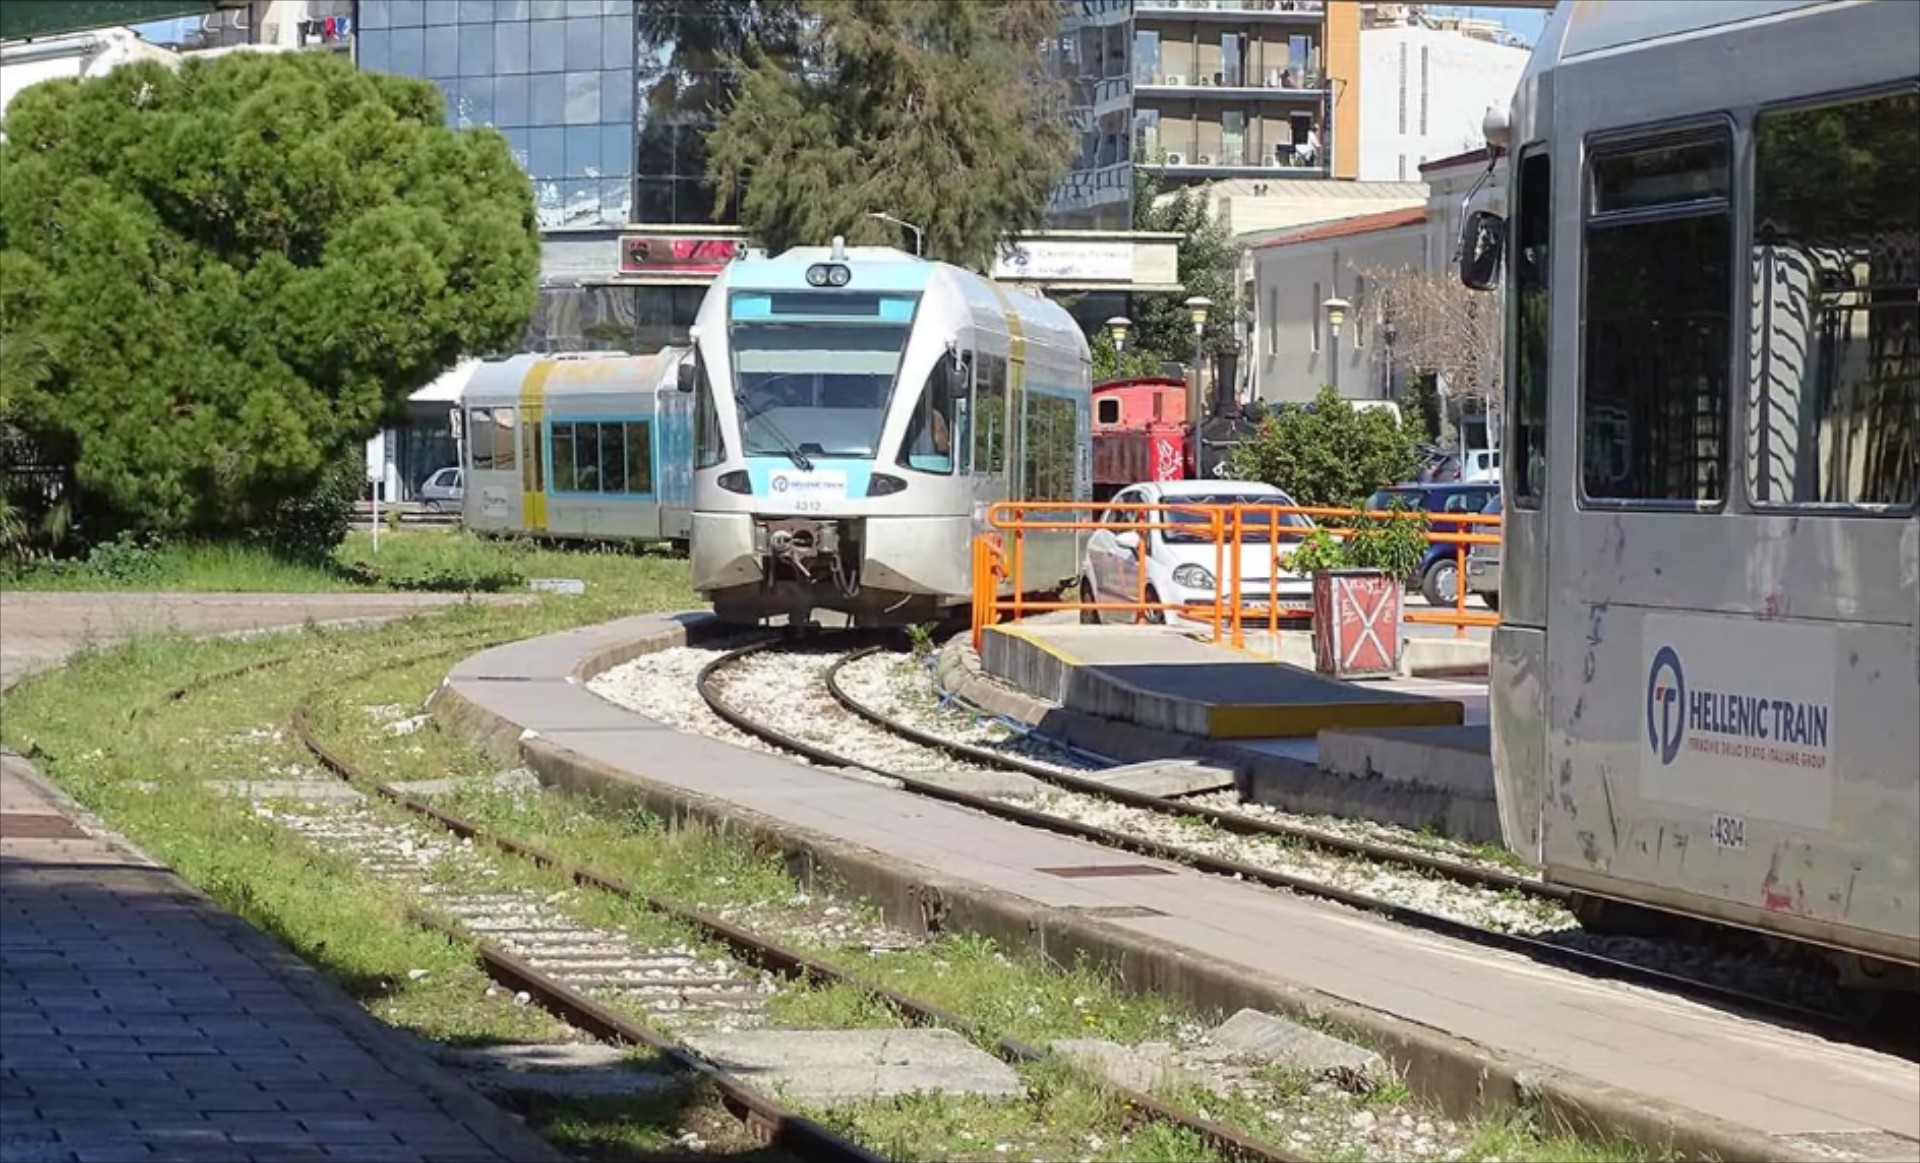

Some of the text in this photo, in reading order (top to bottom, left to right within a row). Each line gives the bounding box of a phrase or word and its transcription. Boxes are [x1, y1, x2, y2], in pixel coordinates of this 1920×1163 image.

[1689, 690, 1827, 747] HELLENIC TRAIN
[1714, 816, 1744, 846] 4304
